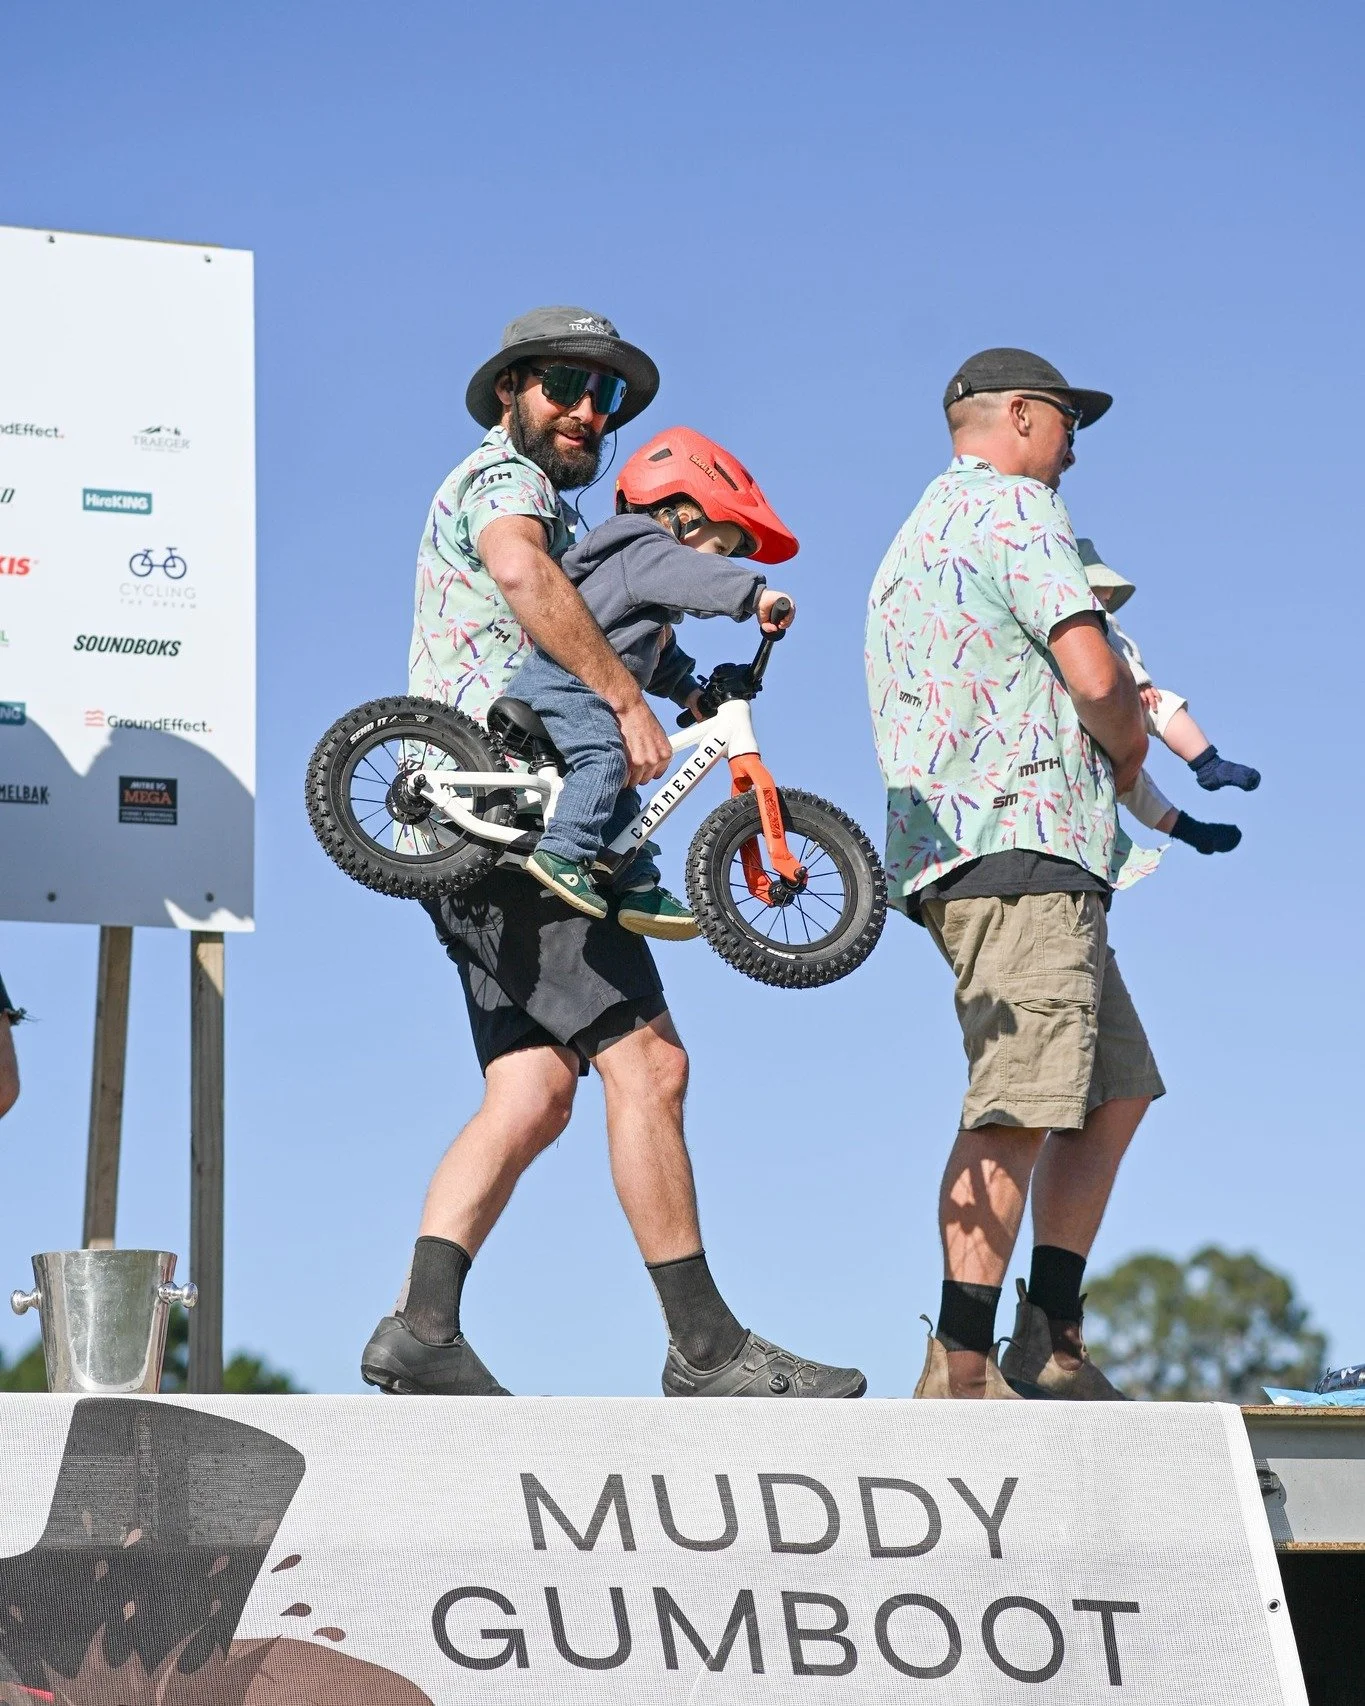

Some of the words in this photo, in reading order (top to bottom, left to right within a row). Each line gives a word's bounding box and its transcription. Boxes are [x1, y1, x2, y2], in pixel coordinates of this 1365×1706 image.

[132, 435, 190, 449] TRAEGER
[689, 454, 718, 481] SMITH
[85, 493, 149, 510] HireKING
[119, 582, 197, 600] CYCLING
[73, 634, 182, 657] SOUNDBOKS
[349, 721, 375, 745] SEND
[377, 716, 389, 728] IT
[124, 789, 172, 805] MEGA
[630, 736, 727, 840] COMMENCAL
[519, 1472, 1019, 1560] MUDDY
[431, 1586, 1141, 1687] GUMBOOT
